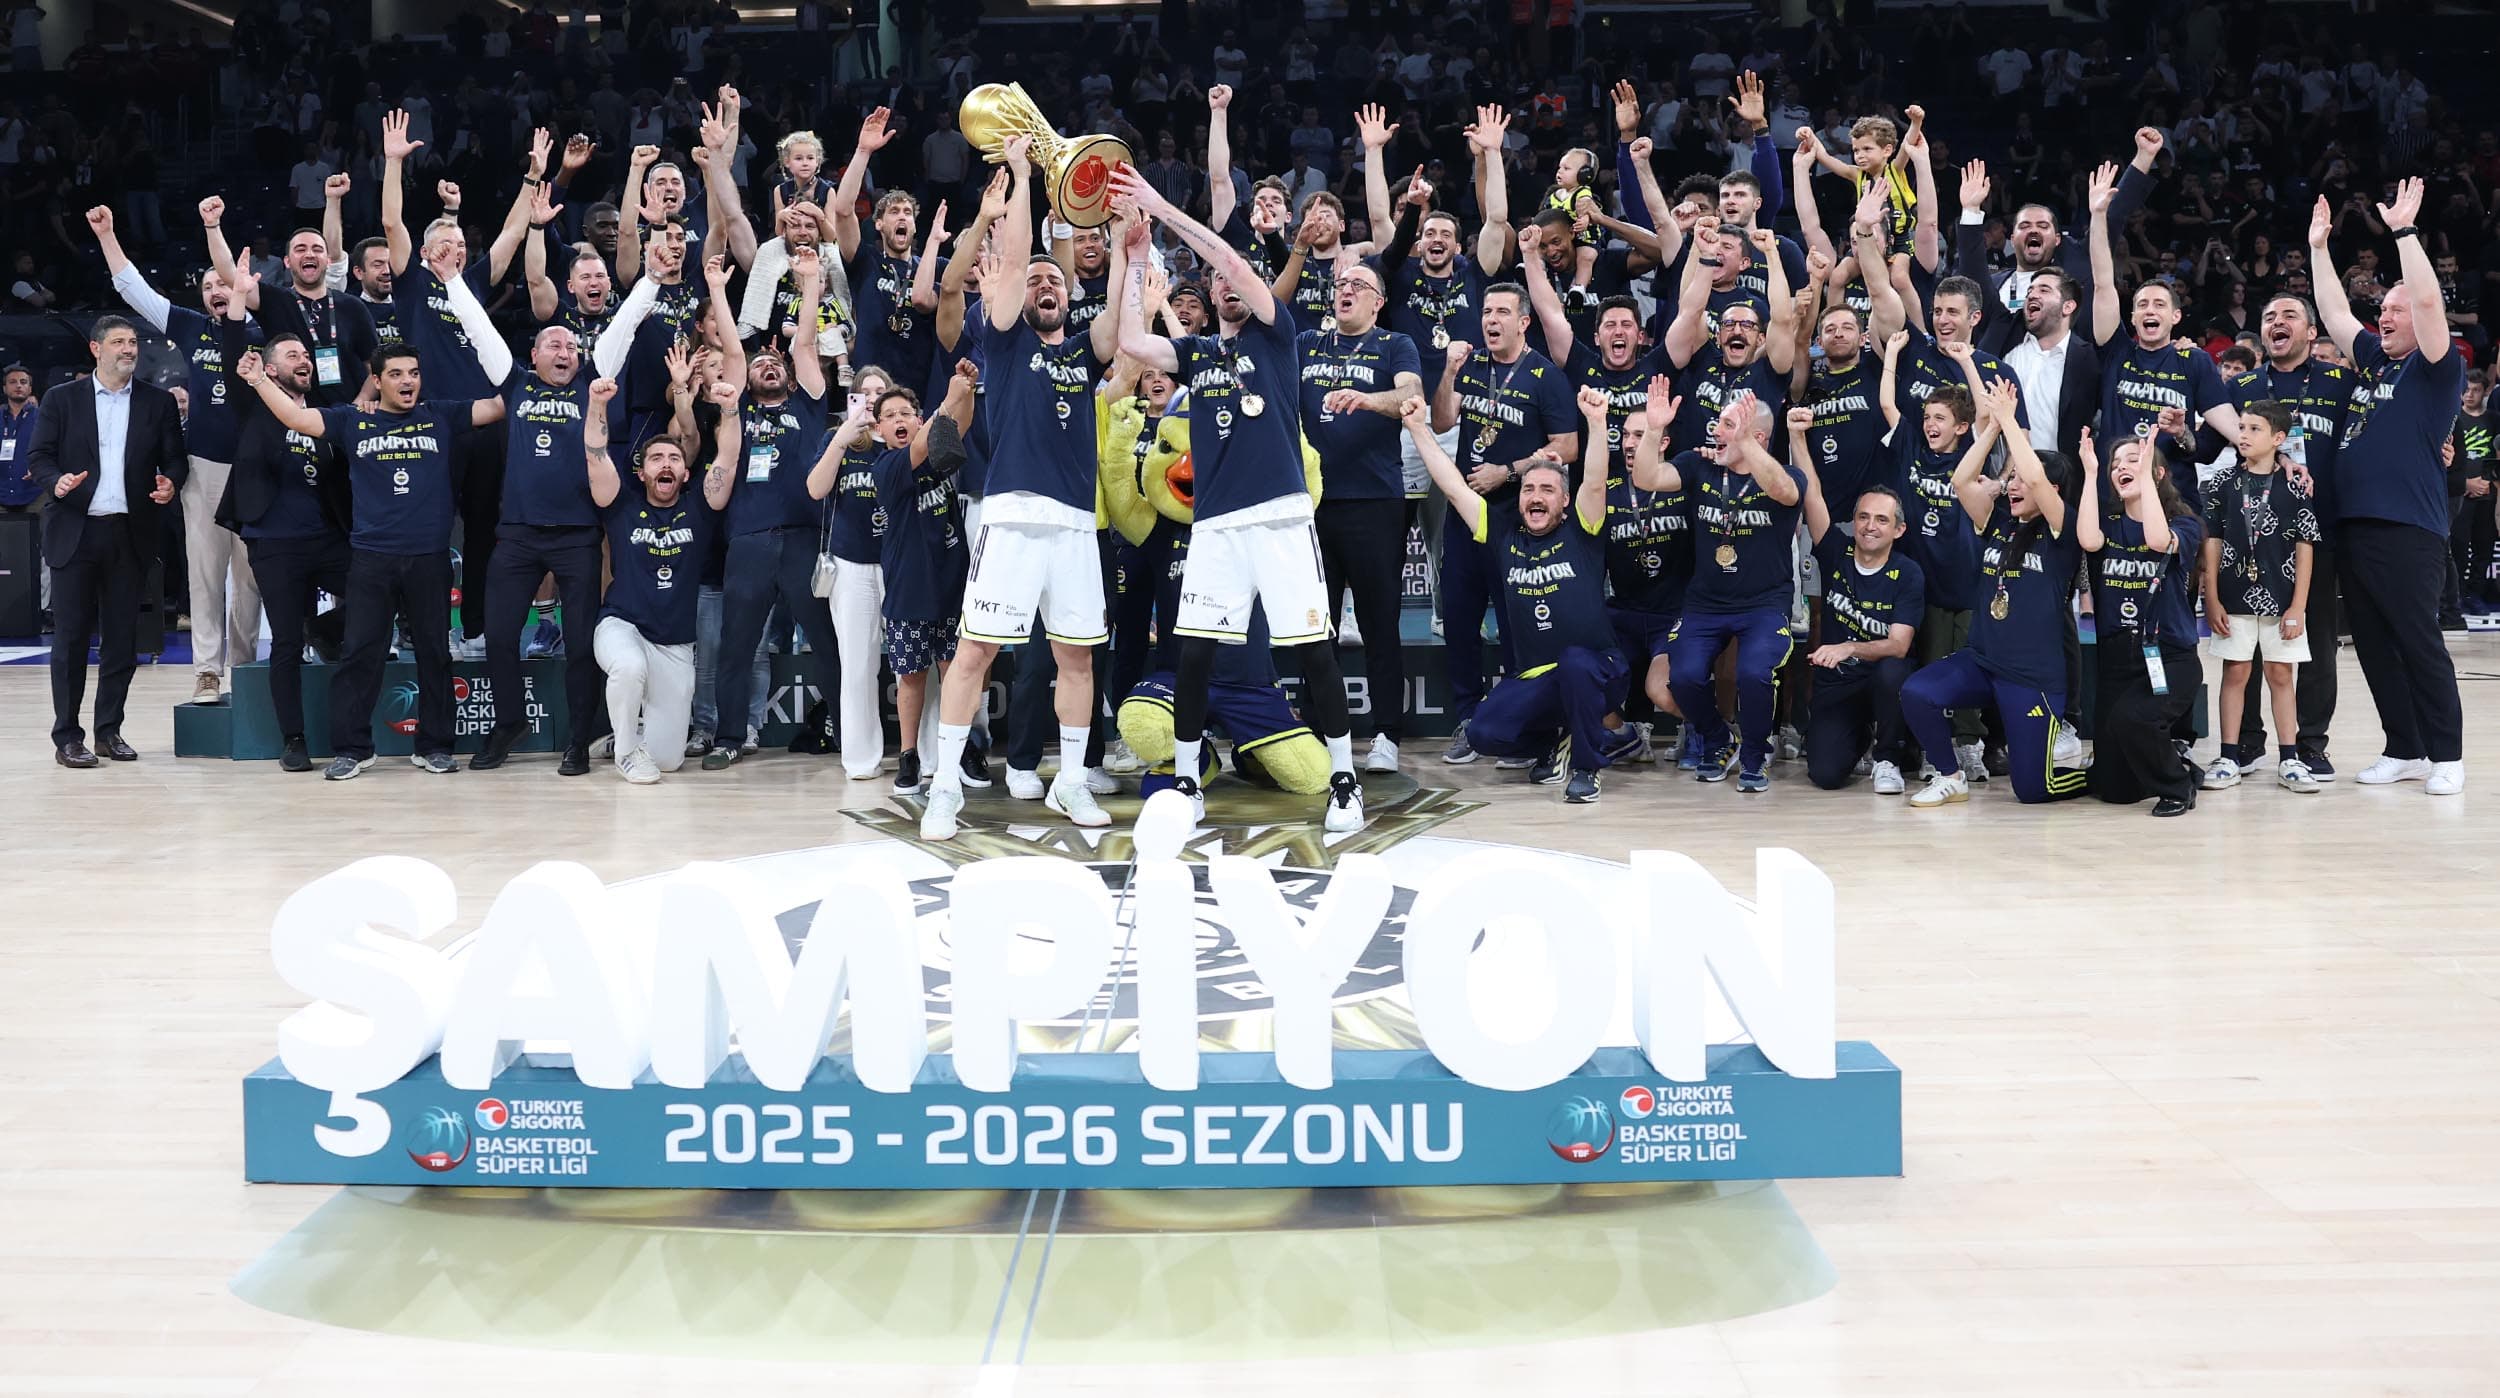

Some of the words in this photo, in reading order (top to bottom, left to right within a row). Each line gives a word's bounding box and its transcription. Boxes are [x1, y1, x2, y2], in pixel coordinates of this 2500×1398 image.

[1302, 363, 1375, 385] ŞAMYON
[1461, 394, 1525, 427] AMYON
[1809, 395, 1870, 417] MPİYON
[356, 435, 439, 458] ŞAMPİYON
[1698, 504, 1773, 526] ŞAMYON
[974, 598, 1000, 613] YKT
[270, 789, 1837, 1158] ŞAMPİYON
[664, 1104, 854, 1166] 2025
[876, 1132, 903, 1147] -
[924, 1104, 1118, 1166] 2026
[1140, 1102, 1465, 1167] SEZONU
[1620, 1123, 1747, 1143] BASKETBOL
[475, 1137, 598, 1155] BASKETBOL
[1572, 1149, 1590, 1159] TBF
[1620, 1143, 1691, 1163] SÜPER
[1696, 1140, 1736, 1161] LİGİ
[476, 1155, 544, 1174] SÜPER
[549, 1155, 587, 1174] LİGİ
